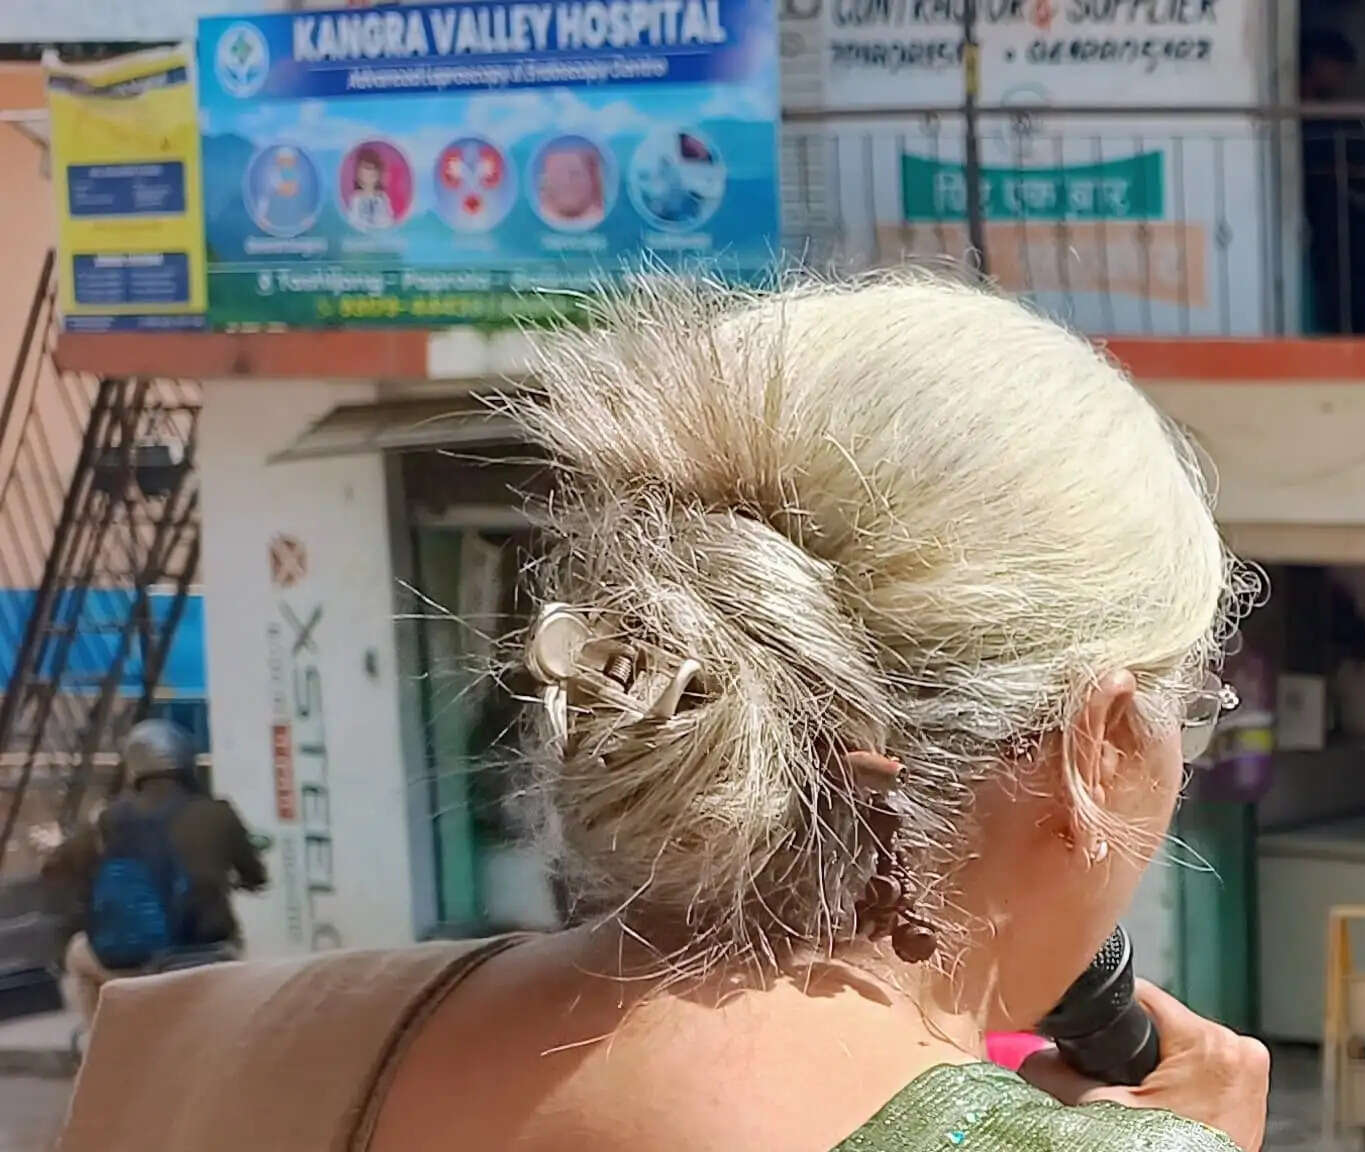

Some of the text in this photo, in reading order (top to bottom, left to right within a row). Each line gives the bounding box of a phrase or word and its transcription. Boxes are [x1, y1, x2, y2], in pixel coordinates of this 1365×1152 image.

[293, 0, 726, 62] KANGRA VALLEY HOSPITAL
